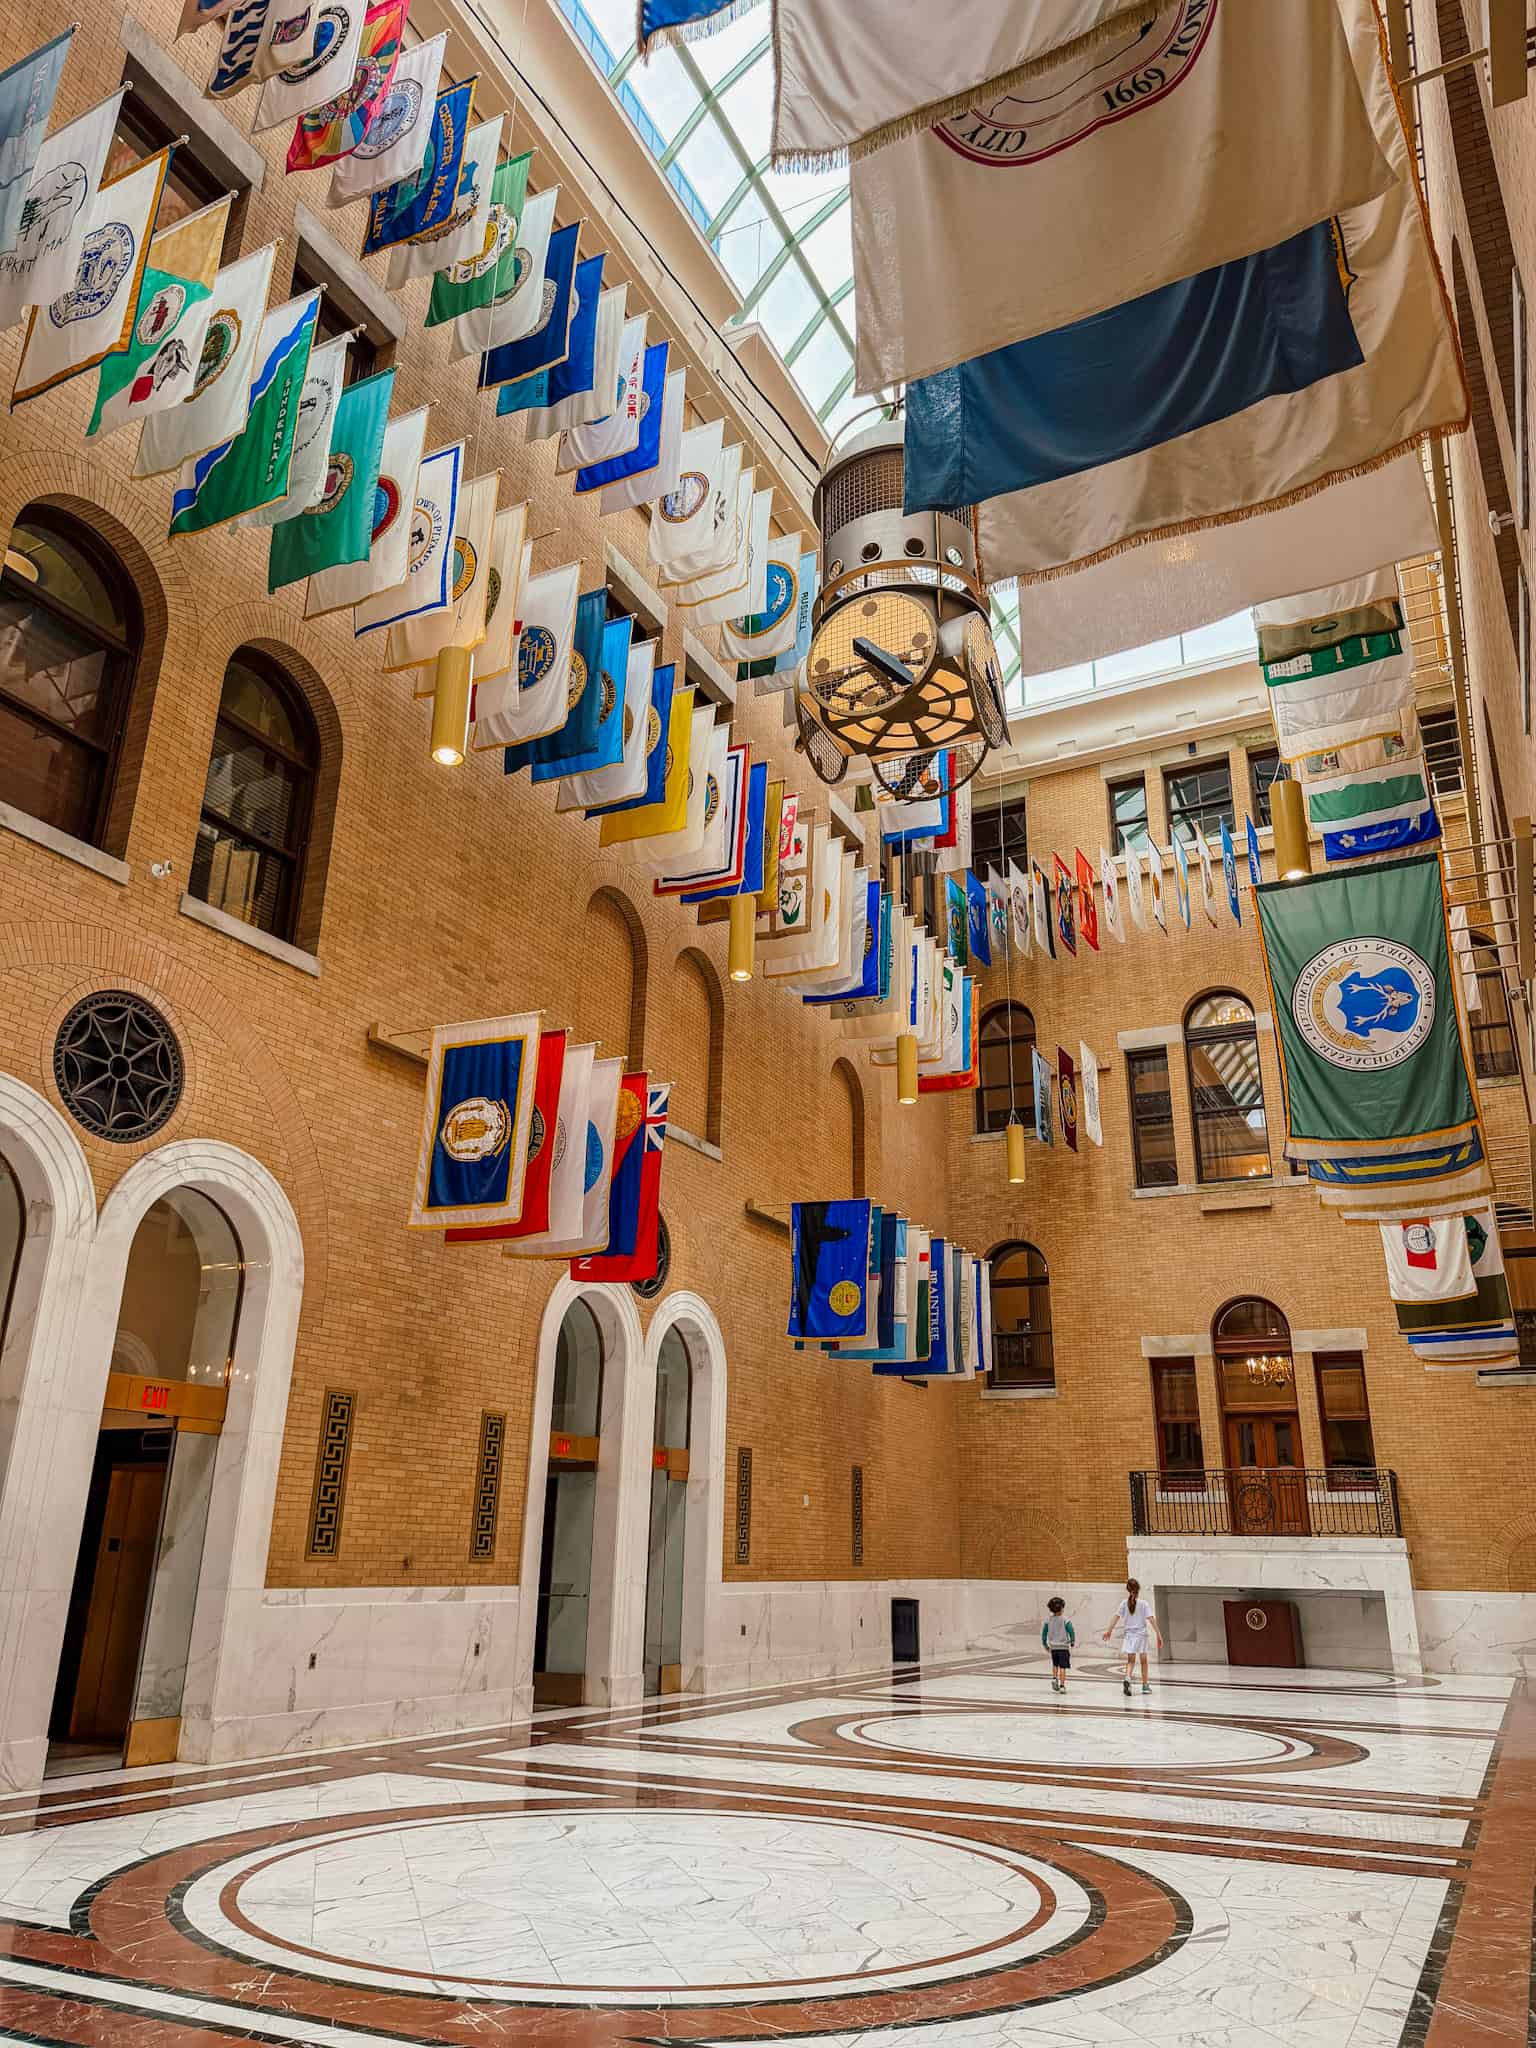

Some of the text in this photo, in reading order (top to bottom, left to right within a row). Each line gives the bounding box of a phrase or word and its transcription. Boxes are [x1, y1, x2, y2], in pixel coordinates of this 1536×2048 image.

[1100, 67, 1167, 111] 1669
[961, 124, 1027, 154] CITY
[627, 393, 637, 418] ROWE
[929, 1269, 940, 1342] BRAINTREE
